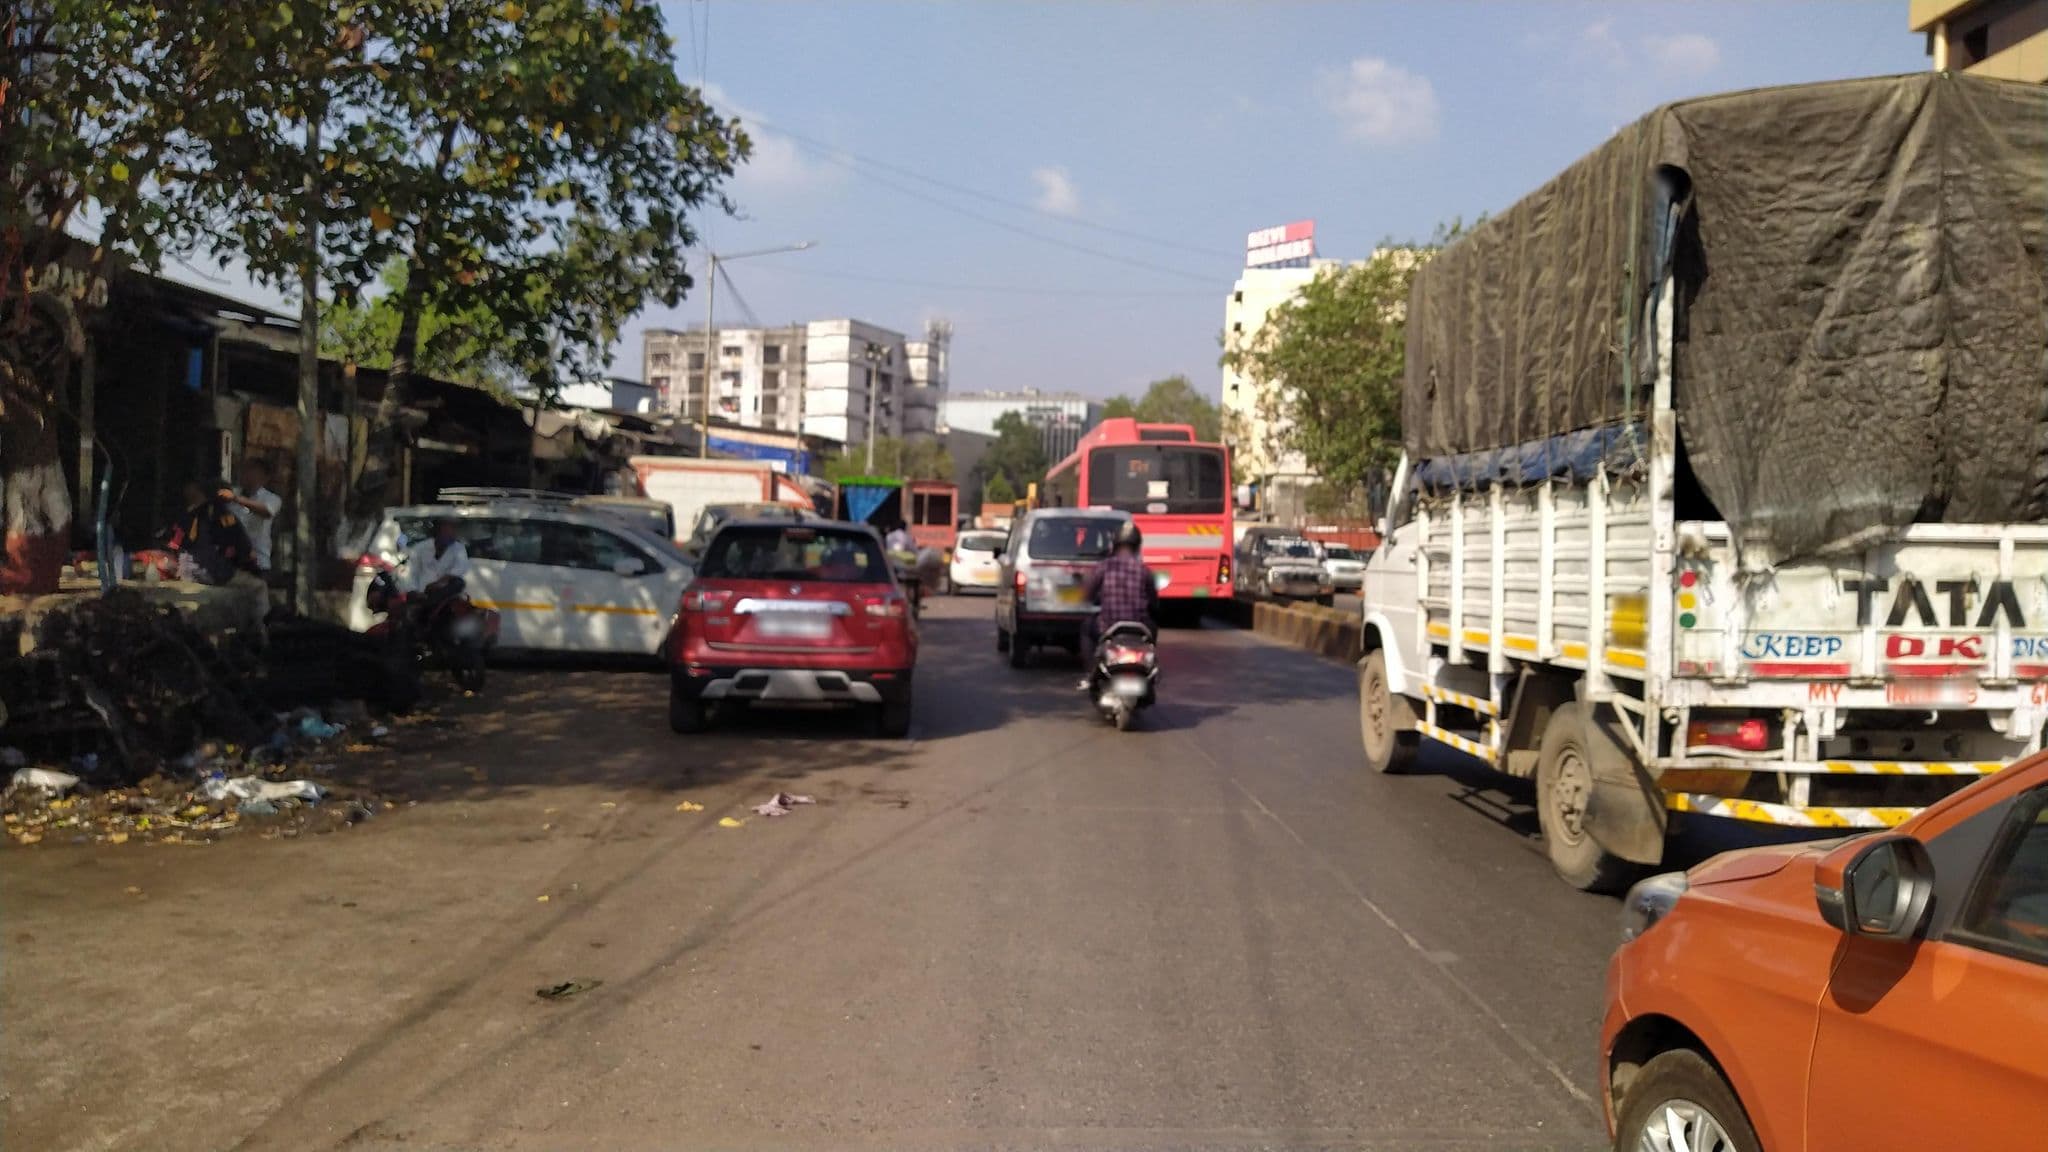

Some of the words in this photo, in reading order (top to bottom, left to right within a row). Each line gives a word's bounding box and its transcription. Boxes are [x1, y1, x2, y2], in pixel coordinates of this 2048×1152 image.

[1844, 580, 2026, 627] TATA
[1743, 634, 1842, 660] KEEP
[1808, 683, 1844, 706] MY
